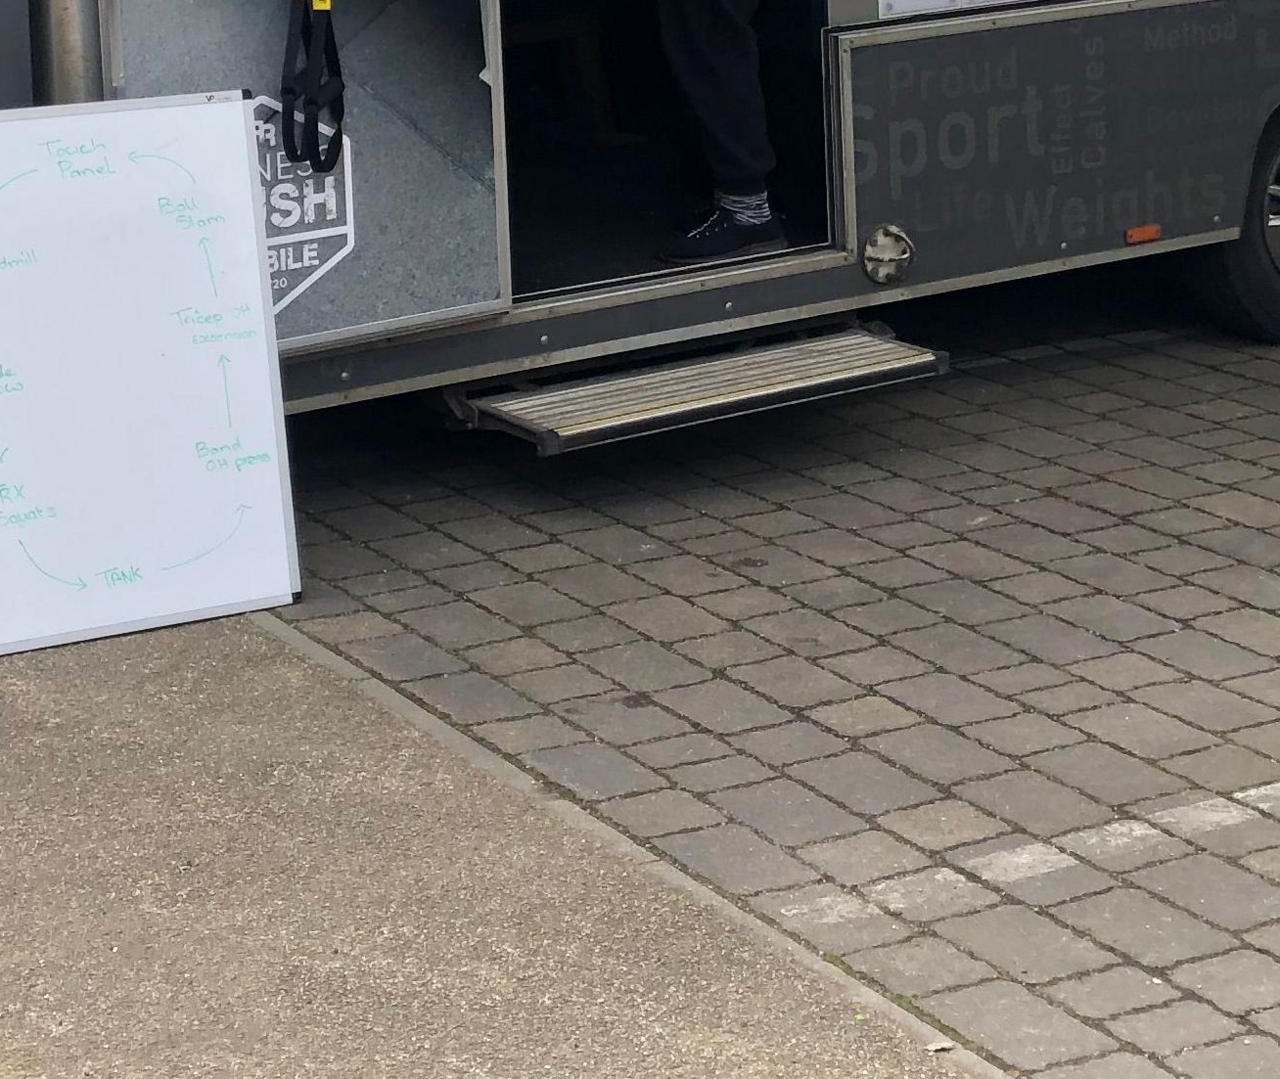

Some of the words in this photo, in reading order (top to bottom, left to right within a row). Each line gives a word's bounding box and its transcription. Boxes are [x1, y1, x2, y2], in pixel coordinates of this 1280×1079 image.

[1144, 16, 1238, 54] Method
[889, 47, 1019, 107] Proud
[1080, 35, 1108, 170] Calves
[38, 137, 108, 158] Touch
[57, 156, 117, 179] Panel
[158, 197, 200, 215] Ball
[1004, 170, 1228, 251] Weights
[176, 214, 226, 230] Slam
[195, 435, 241, 458] Band
